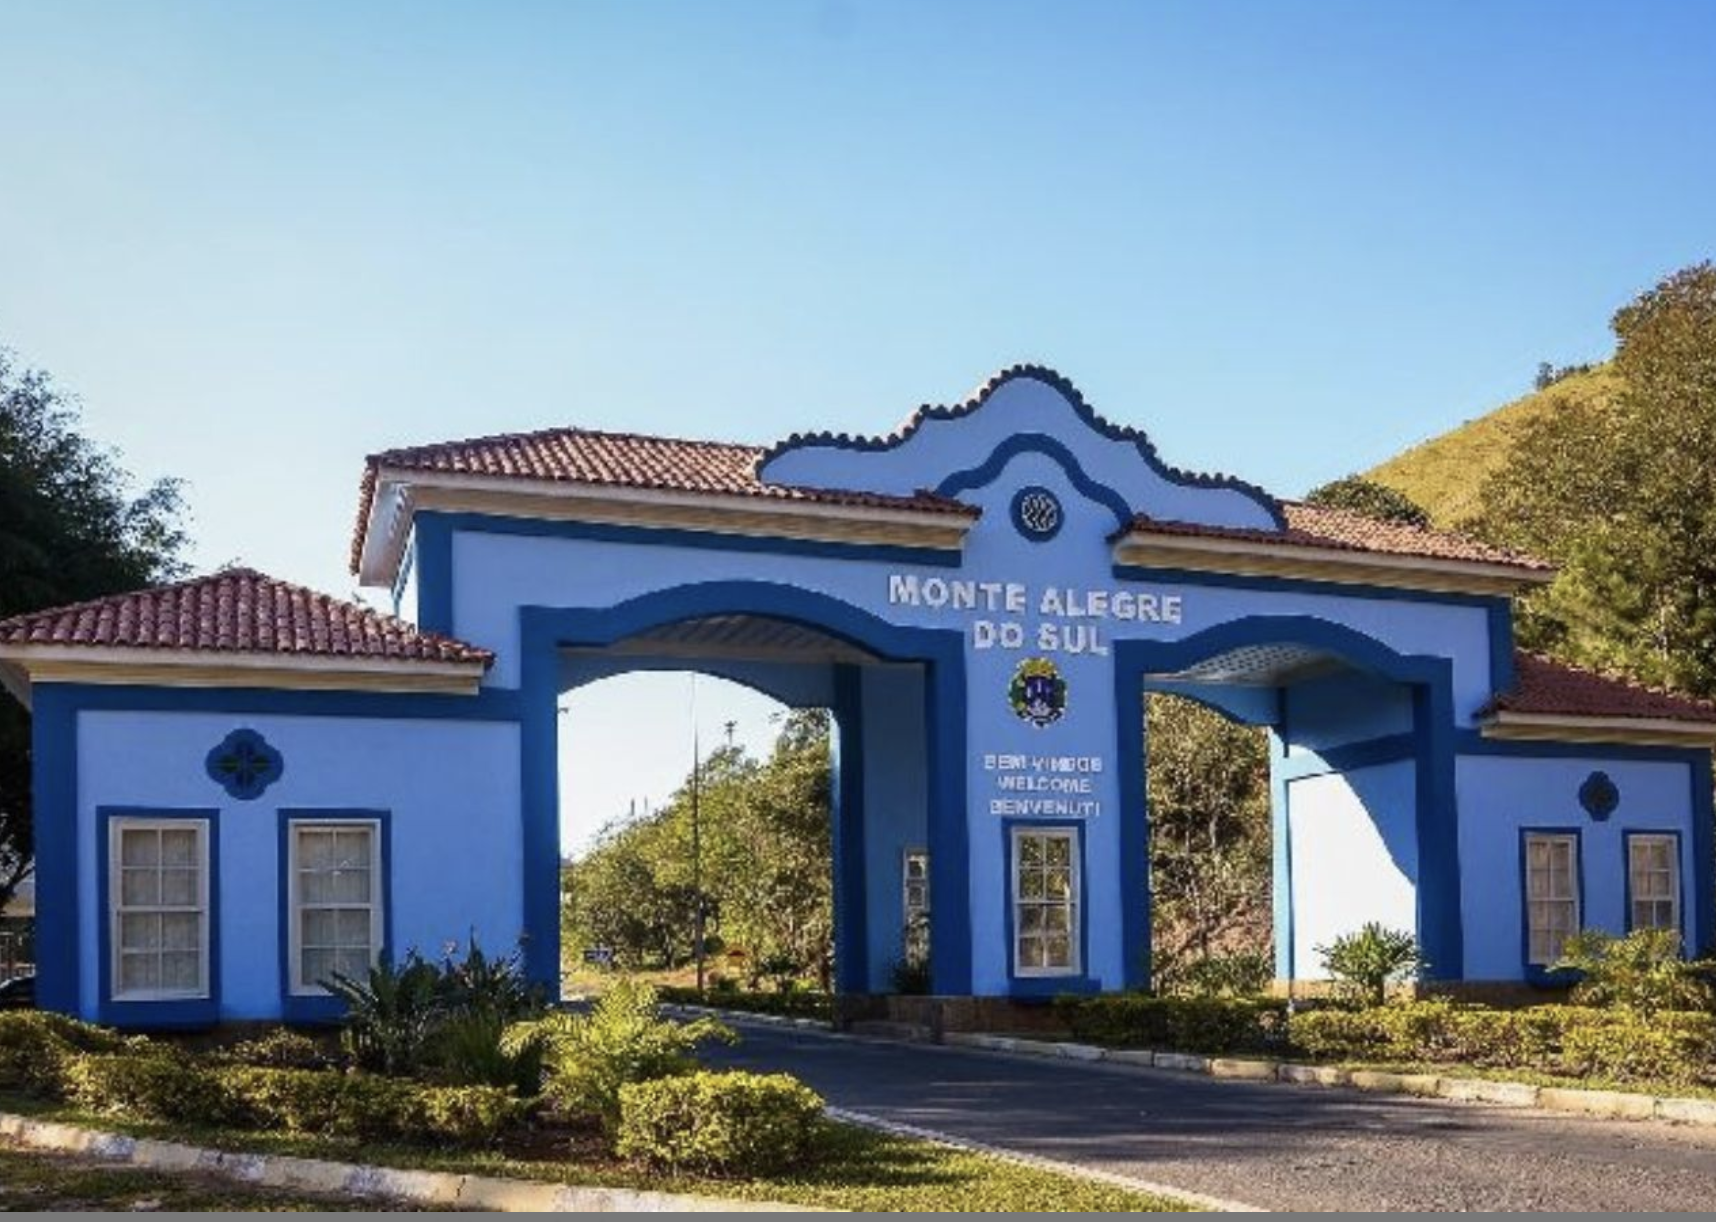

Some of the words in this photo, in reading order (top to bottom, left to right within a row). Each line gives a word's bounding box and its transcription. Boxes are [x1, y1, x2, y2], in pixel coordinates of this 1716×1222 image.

[889, 574, 1026, 613] MONTE
[1040, 587, 1182, 623] ALEGRE
[973, 620, 1023, 649] DO
[1037, 623, 1108, 655] SUL
[984, 754, 1026, 770] BEM
[998, 776, 1091, 793] WELCOME
[990, 799, 1100, 817] BENVENUTI
